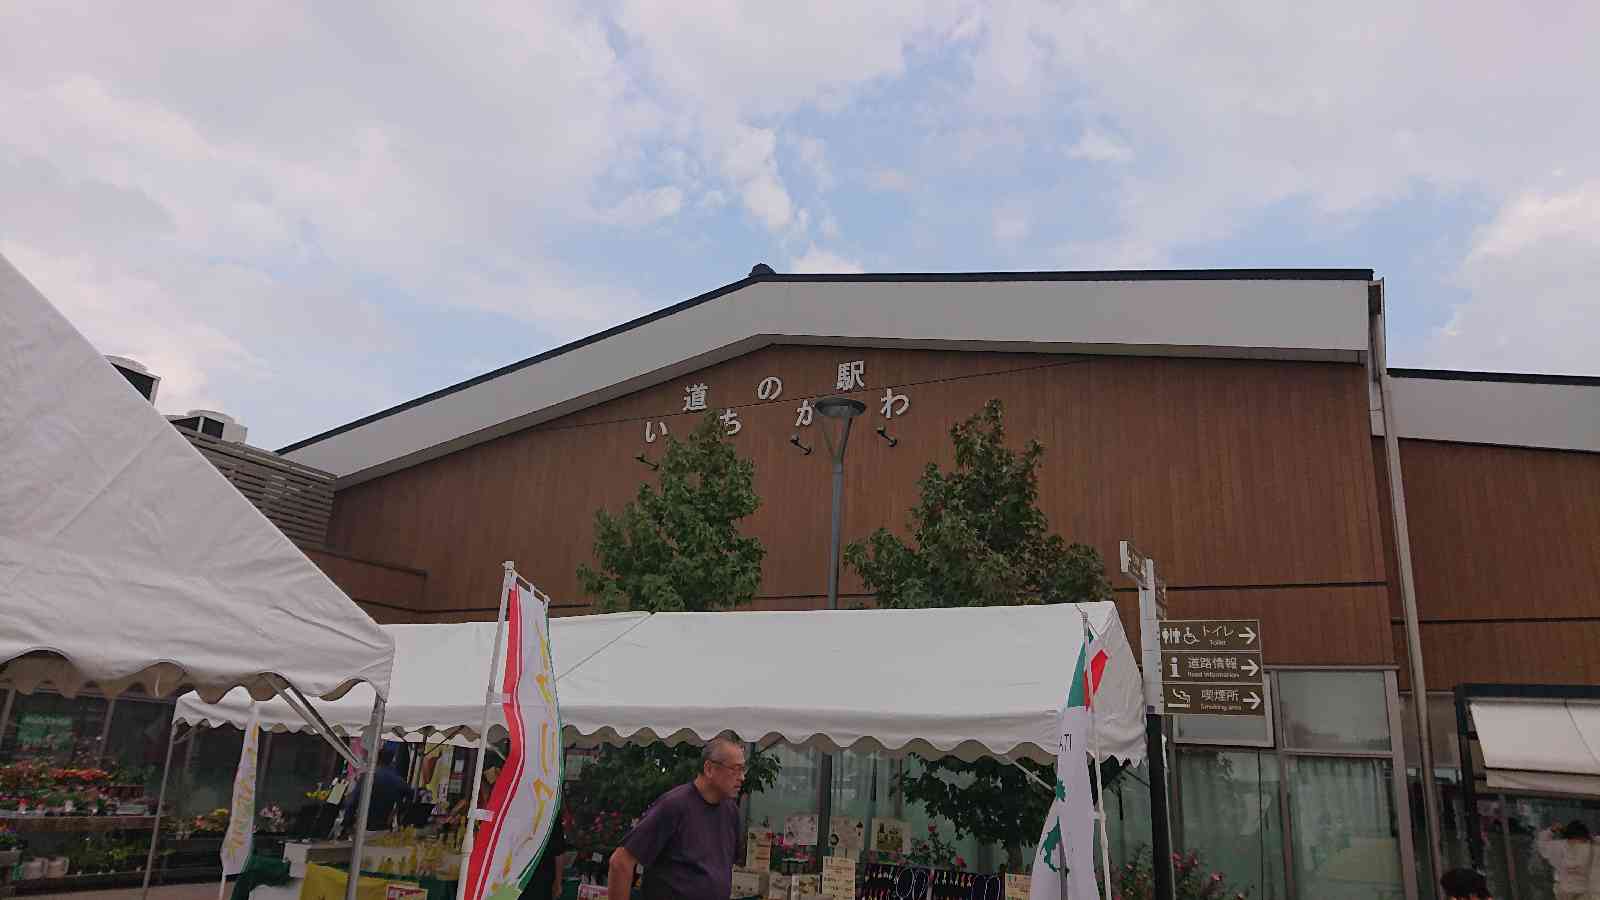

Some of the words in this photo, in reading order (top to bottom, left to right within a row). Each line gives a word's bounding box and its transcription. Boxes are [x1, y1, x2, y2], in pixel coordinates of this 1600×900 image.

[683, 360, 866, 412] 道の駅
[645, 388, 910, 443] いちかわ
[1202, 623, 1234, 637] トイレ
[1187, 656, 1237, 669] 道路情報
[1201, 688, 1239, 702] 喫煙所
